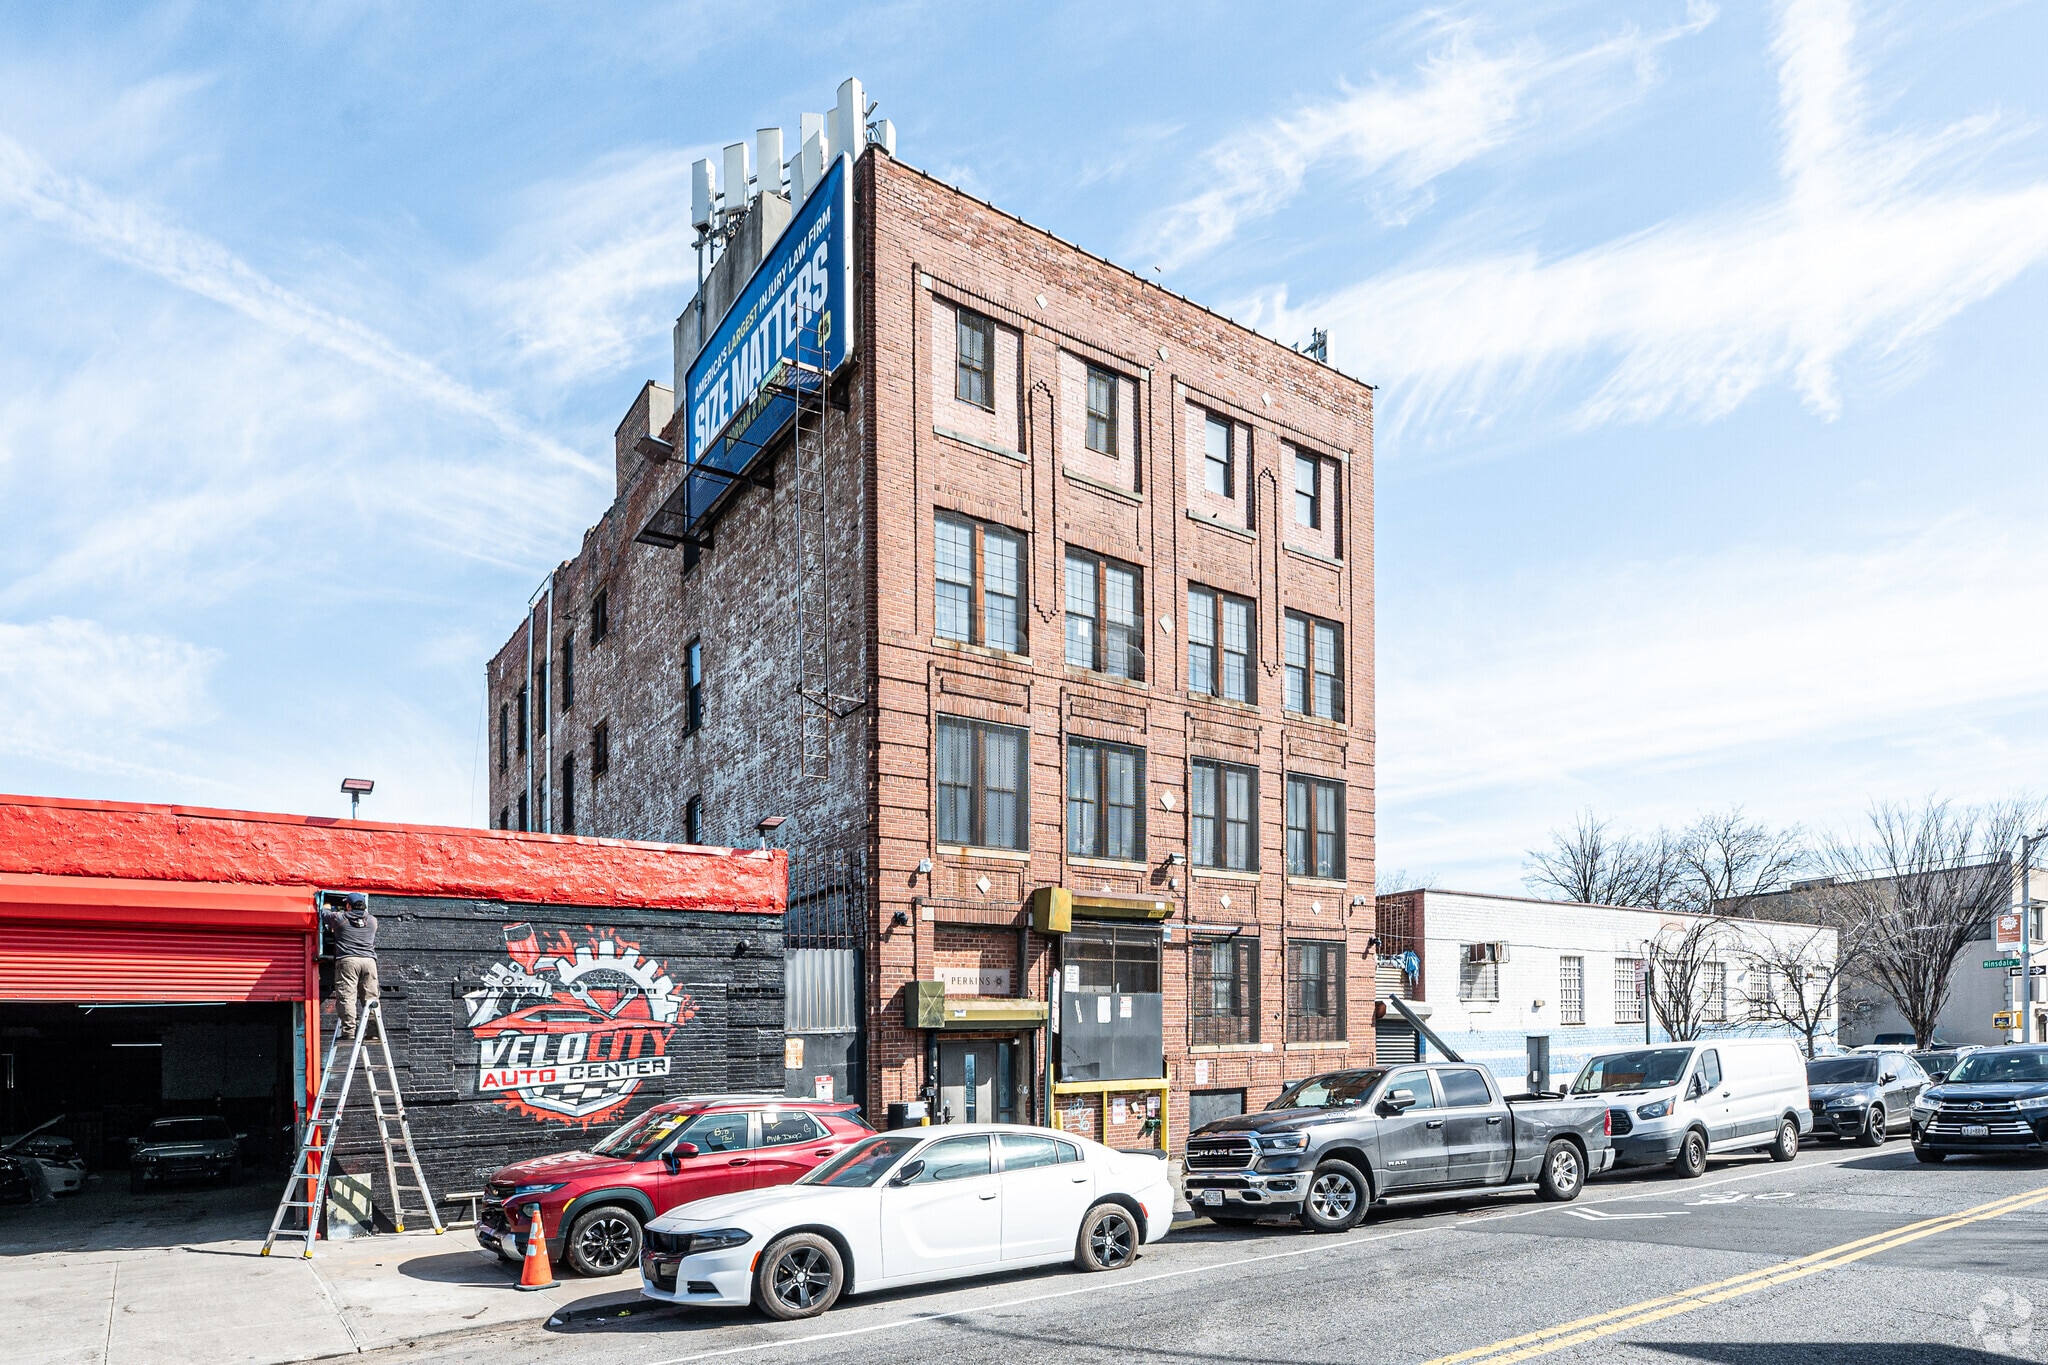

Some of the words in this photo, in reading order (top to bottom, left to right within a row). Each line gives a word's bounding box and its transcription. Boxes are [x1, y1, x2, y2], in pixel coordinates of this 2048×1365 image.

[695, 346, 727, 402] AMERICA'S
[728, 303, 758, 355] LARGEST
[760, 263, 788, 313] INJURY
[789, 237, 807, 273] LAW
[808, 205, 831, 248] FIRM
[695, 368, 729, 459] SIZE
[732, 241, 828, 414] MATTERS
[951, 976, 991, 986] PERKINS
[480, 1028, 677, 1068] VELOCITY
[482, 1069, 556, 1088] AUTO
[569, 1058, 666, 1080] CENTER
